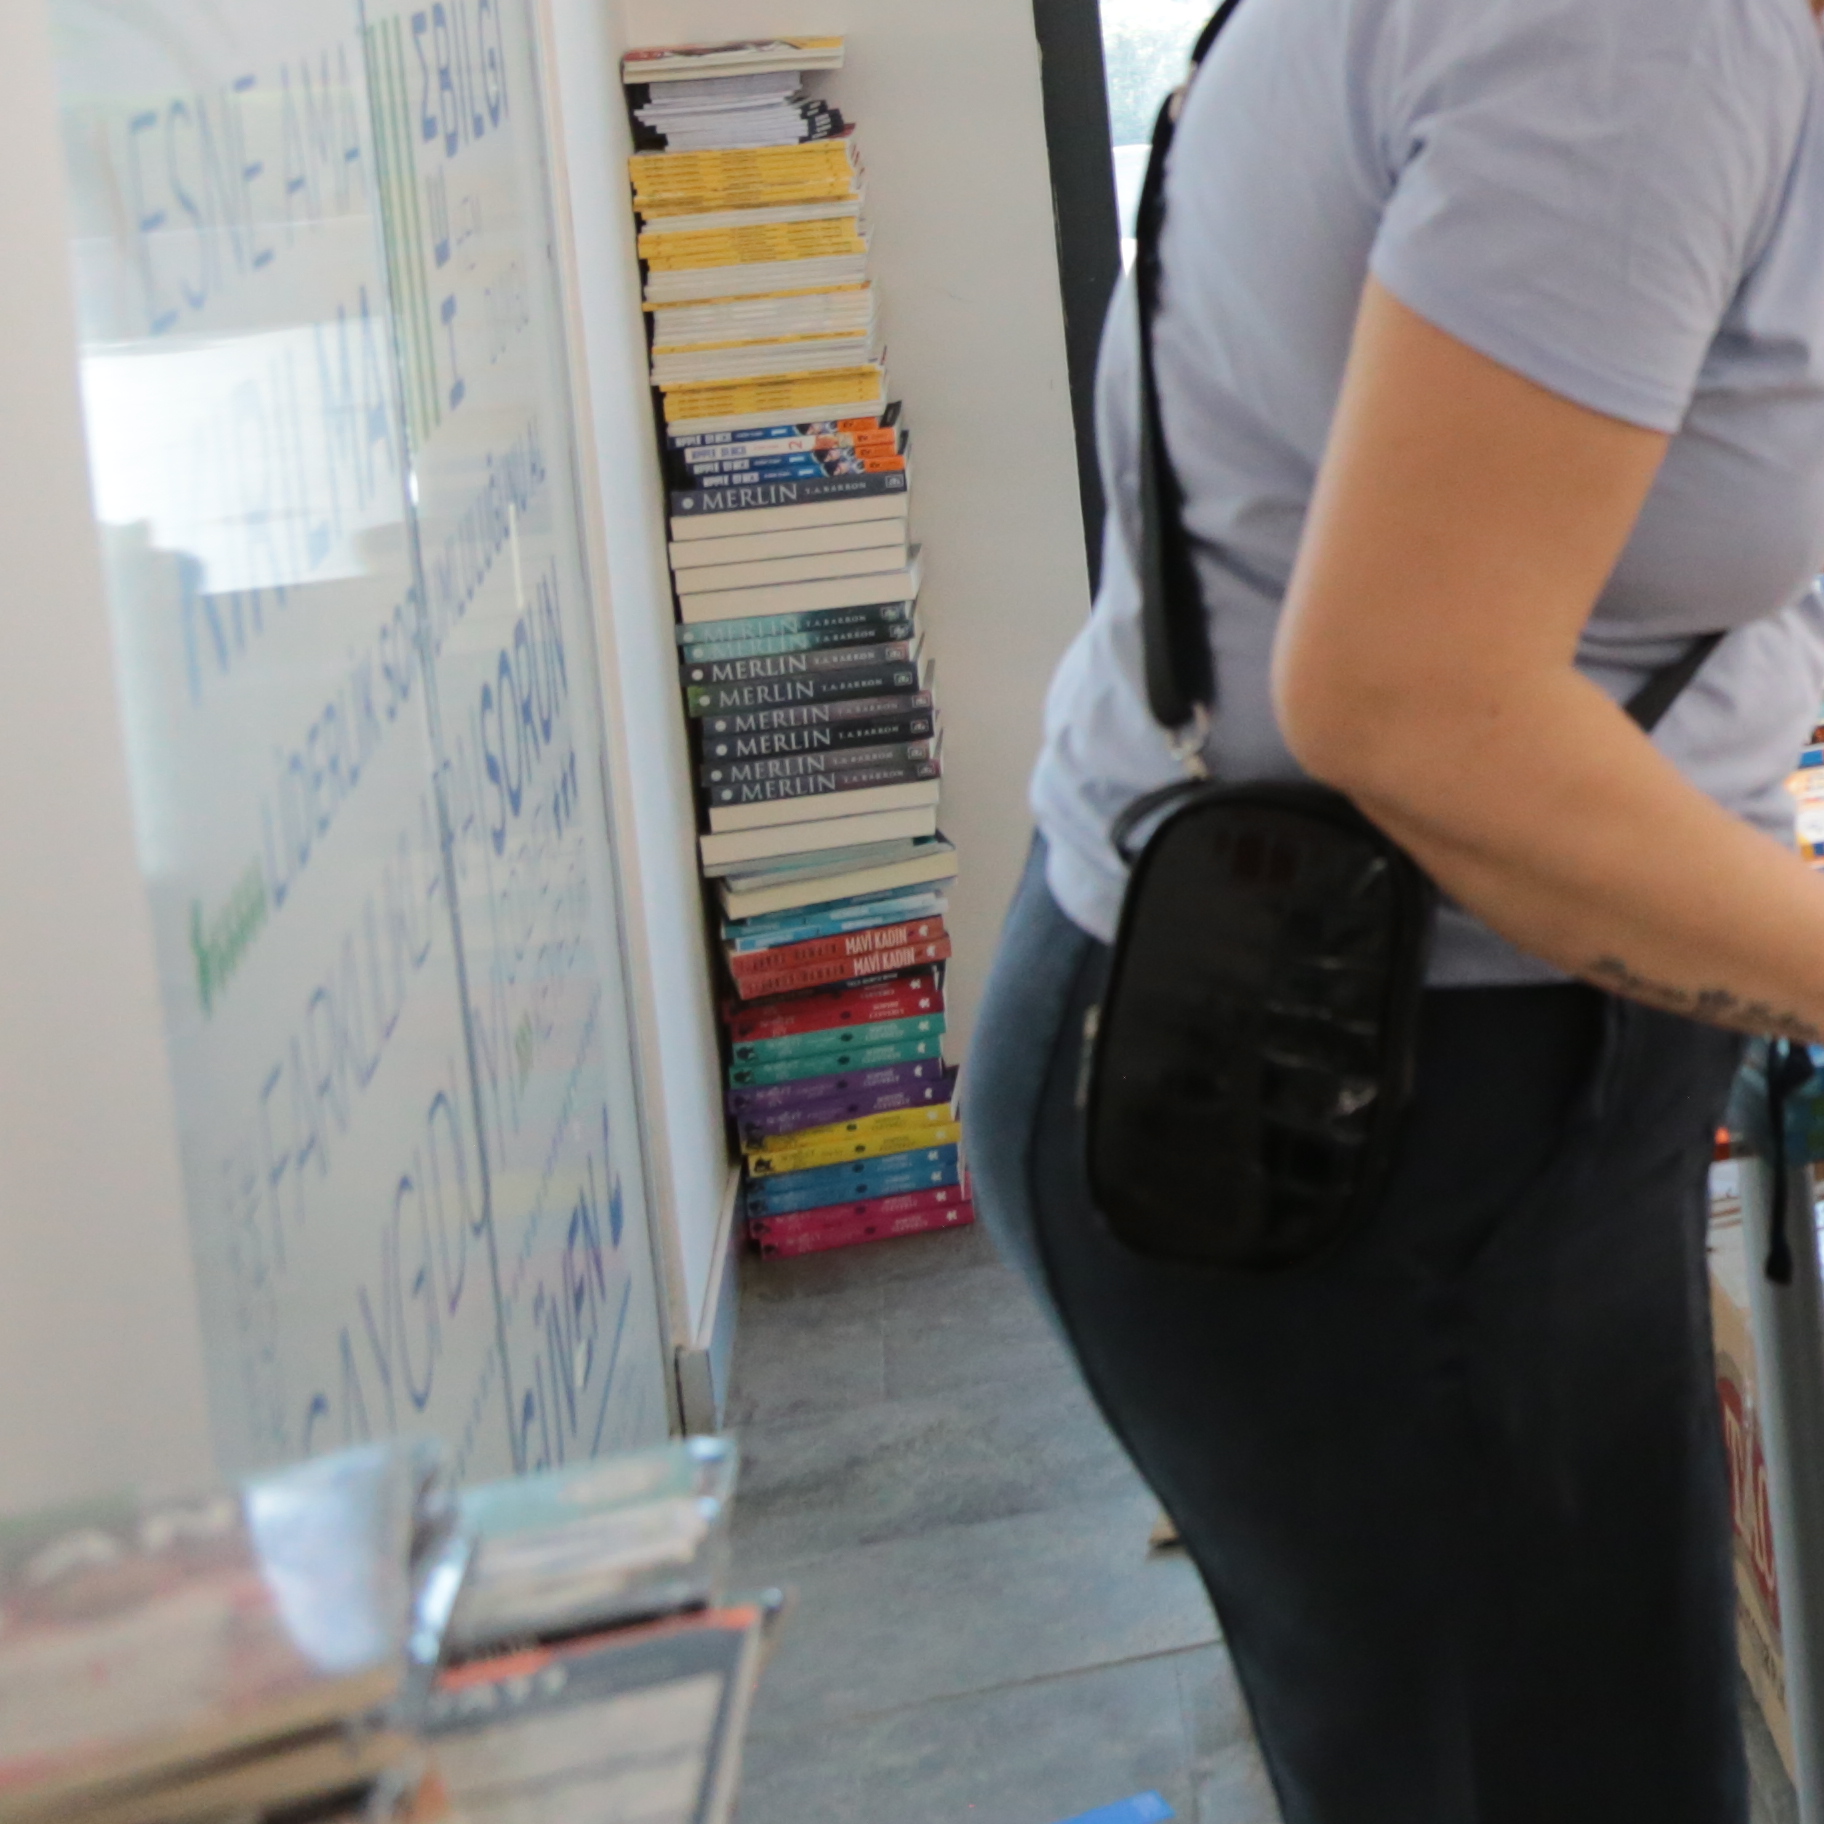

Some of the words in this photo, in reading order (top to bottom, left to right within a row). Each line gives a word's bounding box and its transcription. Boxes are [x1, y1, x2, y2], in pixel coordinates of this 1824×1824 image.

[703, 483, 797, 511] MERLIN
[712, 653, 807, 683] MERLIN
[480, 554, 569, 855] SORUN
[719, 680, 814, 708] MERLIN
[735, 705, 830, 733] MERLIN
[736, 728, 831, 757] MERLIN
[731, 754, 825, 783] MERLIN
[741, 773, 836, 803] MERLIN
[845, 929, 872, 956] MAVİ
[875, 927, 908, 949] KADIN
[853, 950, 880, 976] MAVİ
[883, 947, 916, 968] KADIN
